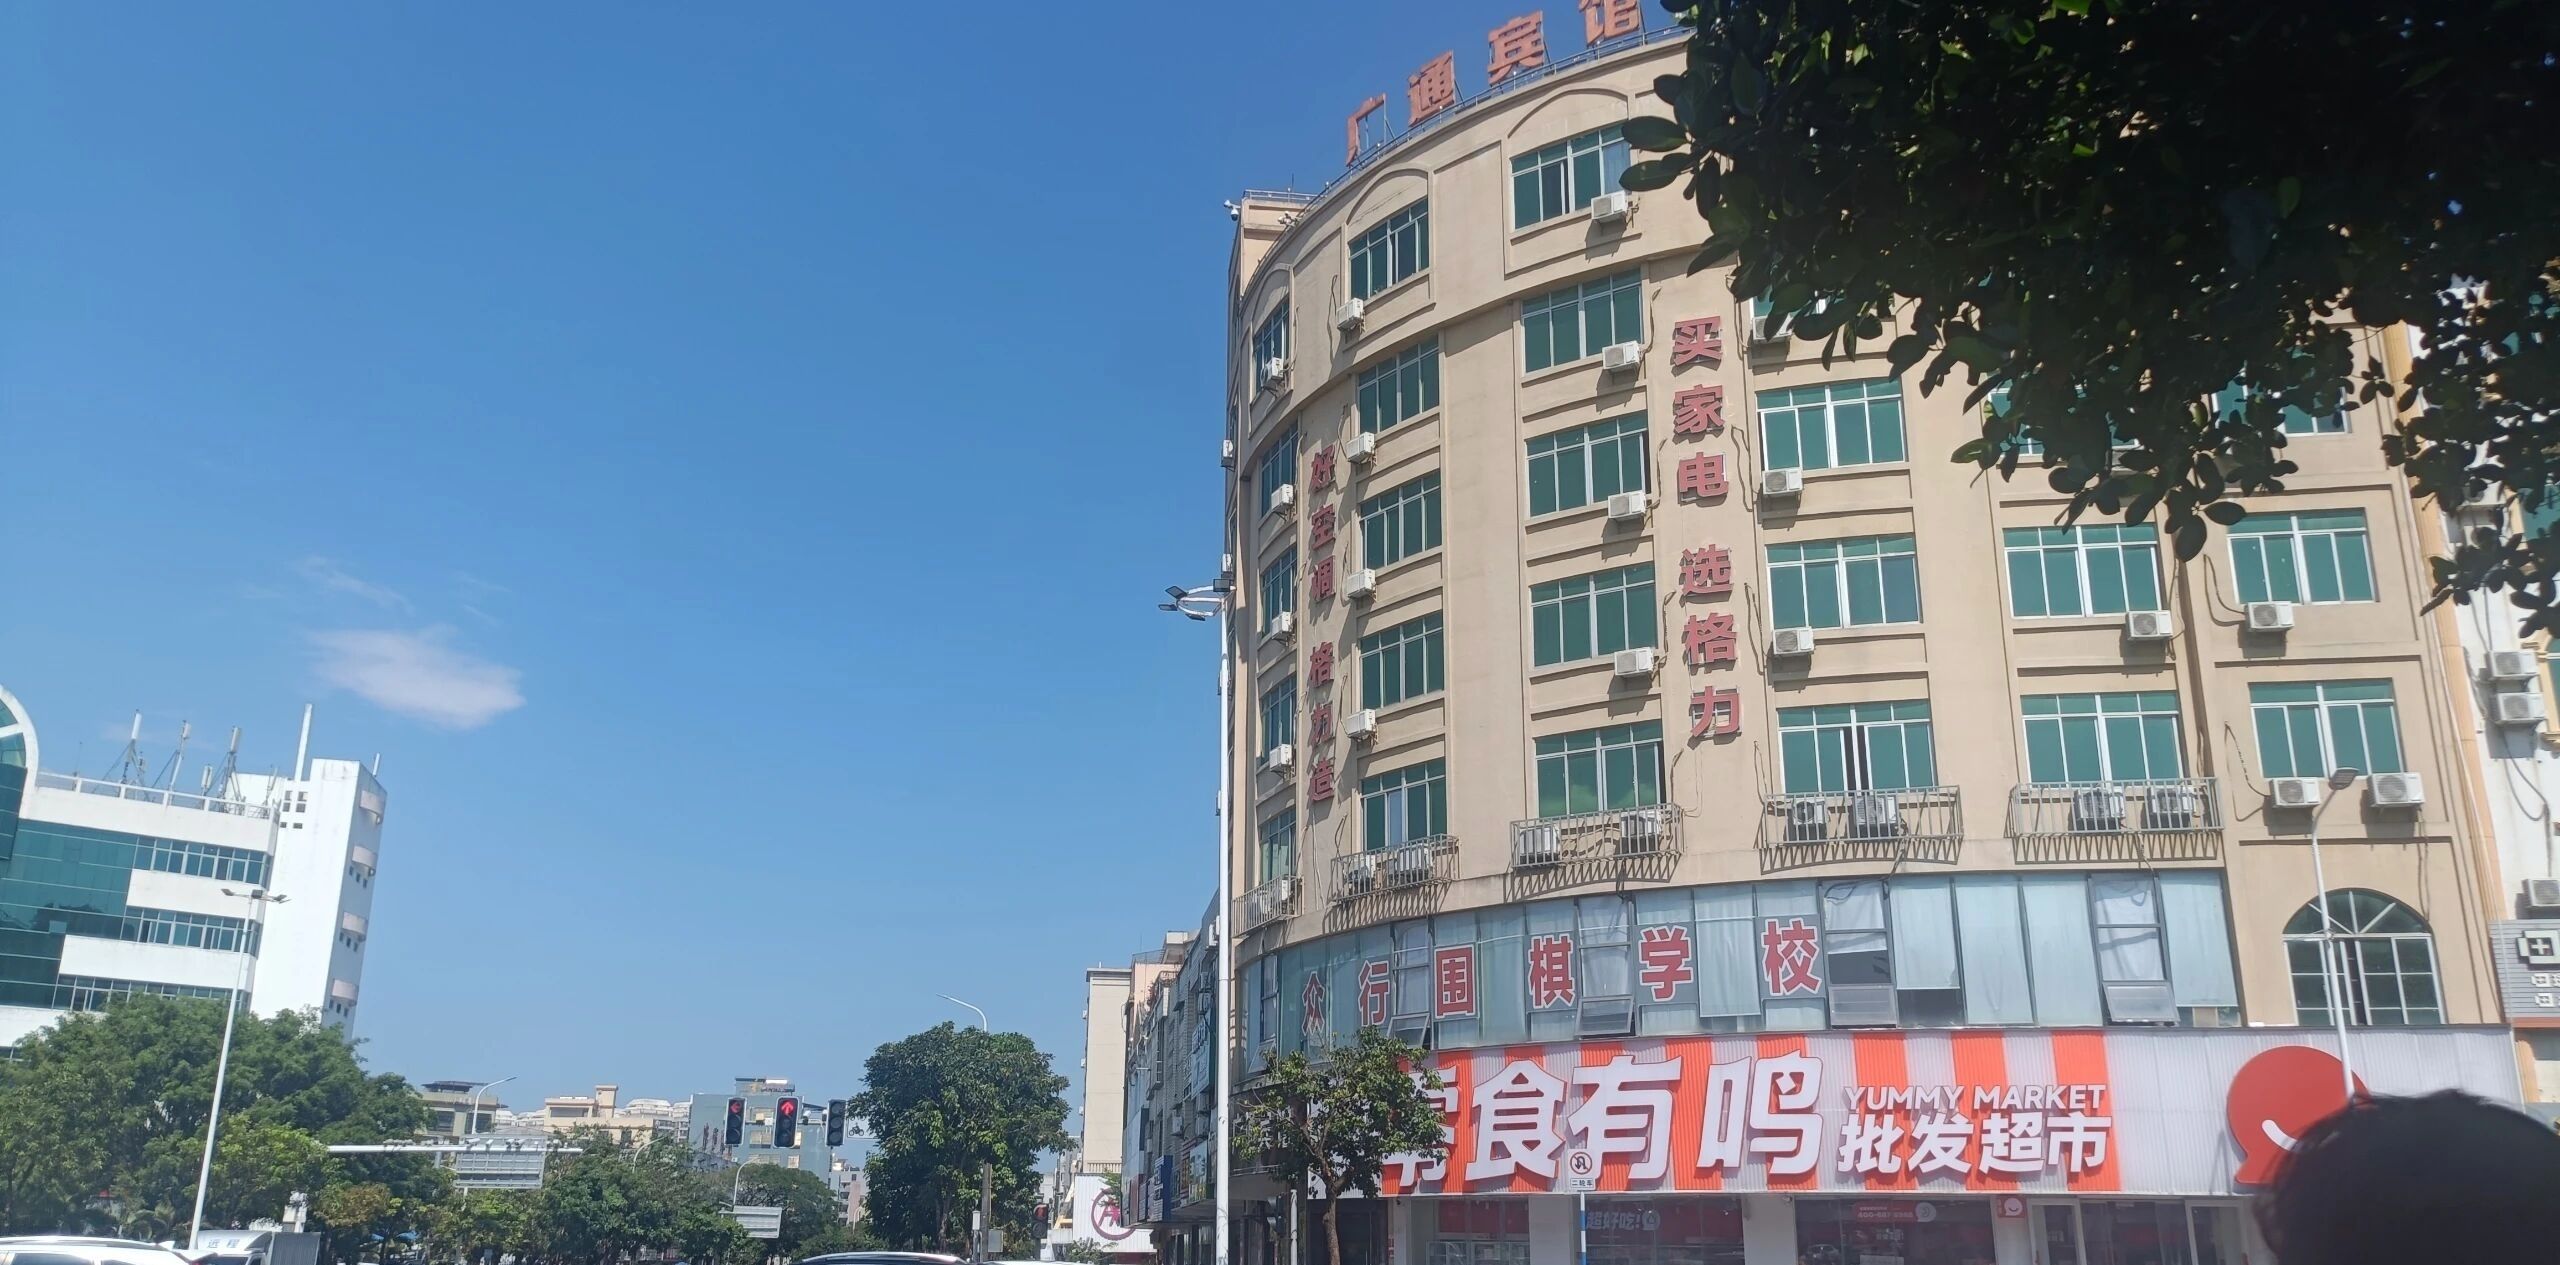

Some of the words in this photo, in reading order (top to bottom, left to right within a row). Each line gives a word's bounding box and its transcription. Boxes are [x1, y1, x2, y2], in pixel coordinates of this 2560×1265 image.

[1346, 0, 1642, 166] 广通宾馆
[1672, 315, 1730, 499] 买家电
[1308, 444, 1336, 603] 好空调
[1679, 544, 1741, 738] 选格力
[1308, 640, 1335, 802] 格力造
[1301, 917, 1823, 1036] 众行围棋学校
[1836, 1111, 2111, 1174] 批发超市
[1843, 1085, 1963, 1111] YUMMY
[1973, 1084, 2106, 1111] MARKET
[1571, 1179, 1593, 1187] 二轮车
